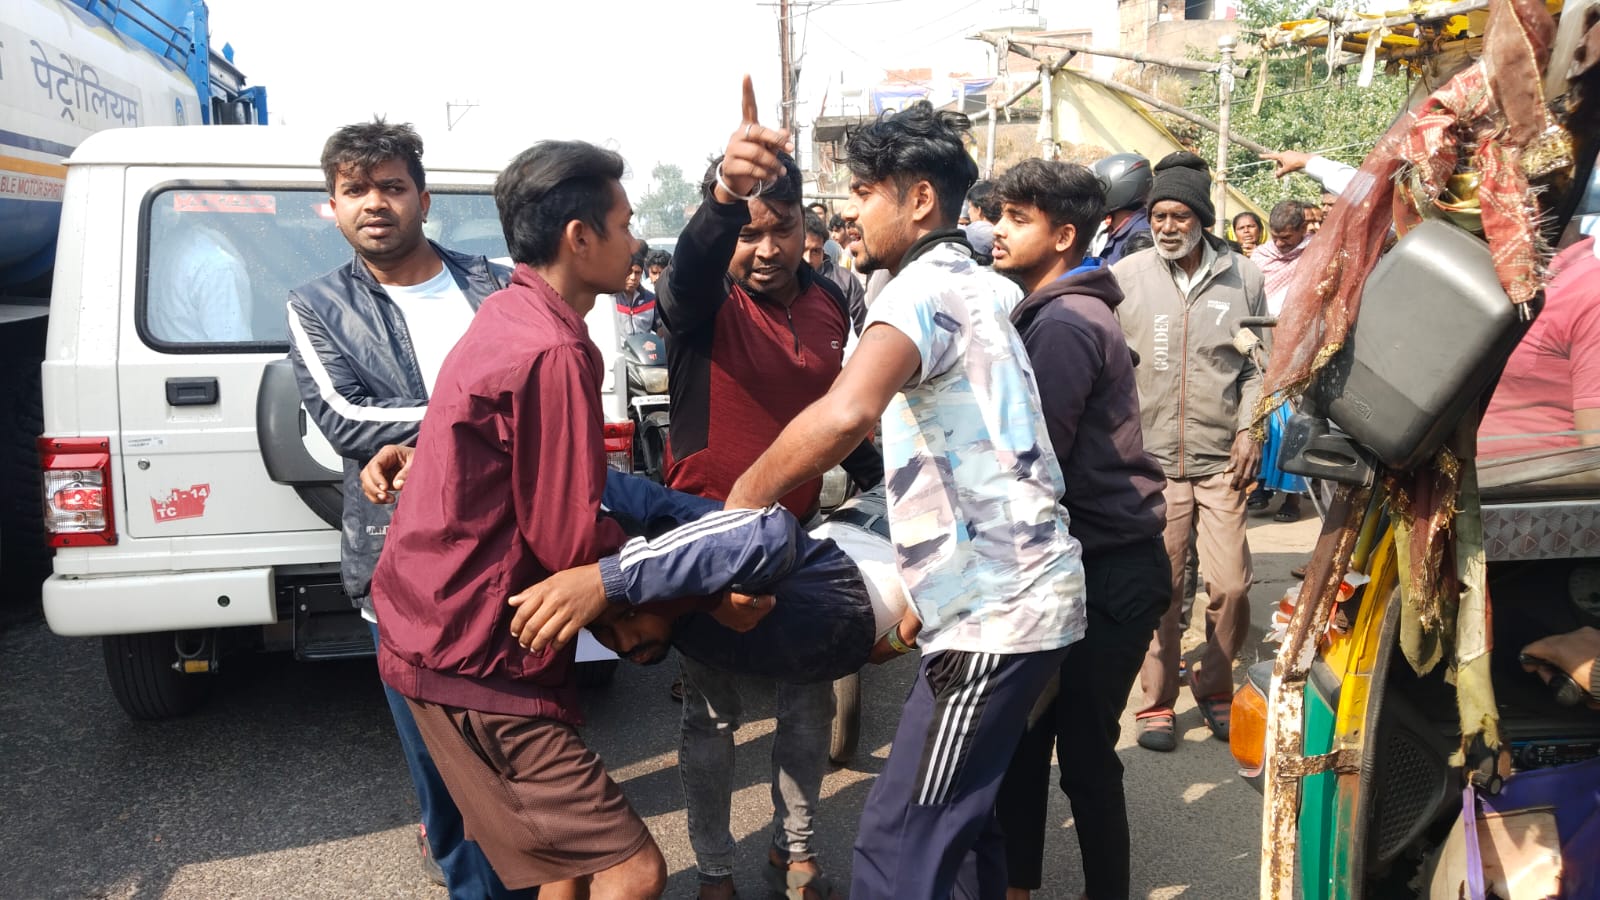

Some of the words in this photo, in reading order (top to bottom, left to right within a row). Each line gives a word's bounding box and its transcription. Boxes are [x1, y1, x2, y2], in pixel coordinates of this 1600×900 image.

[30, 39, 138, 128] पेट्रोलियम
[1153, 314, 1169, 371] GOLDEN
[157, 507, 177, 518] TC
